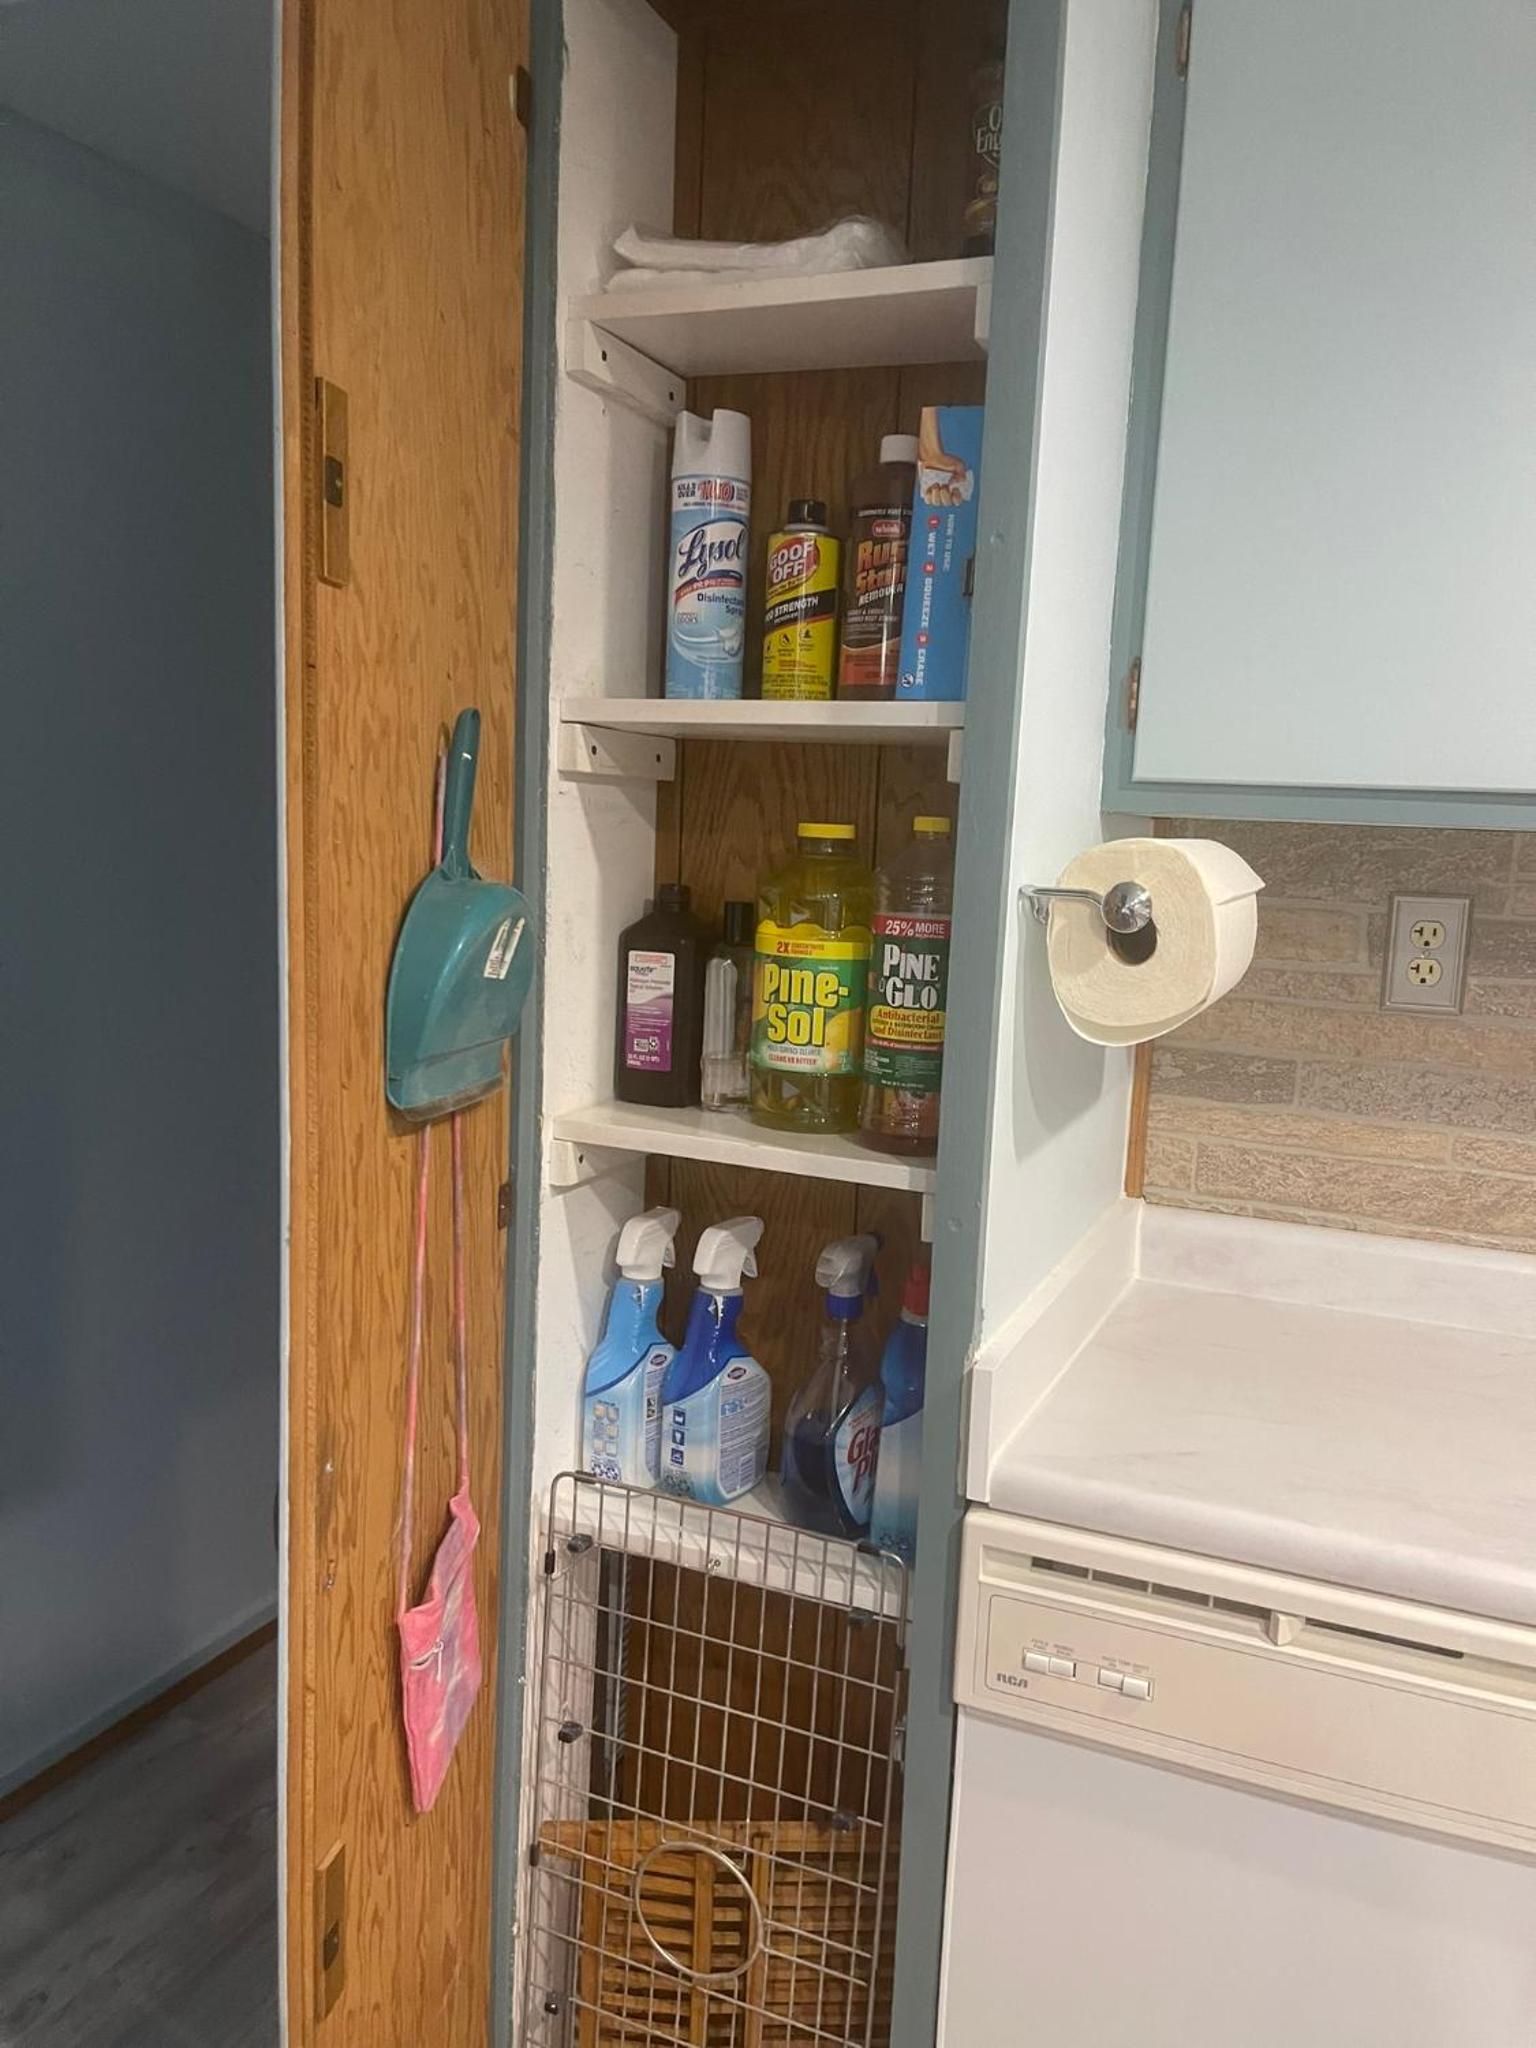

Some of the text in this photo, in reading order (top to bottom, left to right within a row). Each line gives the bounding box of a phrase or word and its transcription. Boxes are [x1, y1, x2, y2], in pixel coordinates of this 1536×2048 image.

[677, 528, 746, 579] Lysol
[769, 540, 815, 571] GOOF
[926, 530, 937, 557] WET
[773, 558, 807, 584] OFF
[774, 596, 819, 617] STRENGTH
[920, 577, 933, 629] SQUEEZE
[914, 647, 926, 687] ERASE
[885, 919, 946, 937] 25% MORE
[776, 941, 790, 955] 2X
[763, 963, 849, 1009] Pine-
[885, 976, 939, 1011] GLO
[767, 1002, 825, 1047] Sol
[876, 1007, 941, 1025] Antibacterial
[888, 1026, 943, 1040] Disinfectant
[996, 1672, 1029, 1689] RCA
